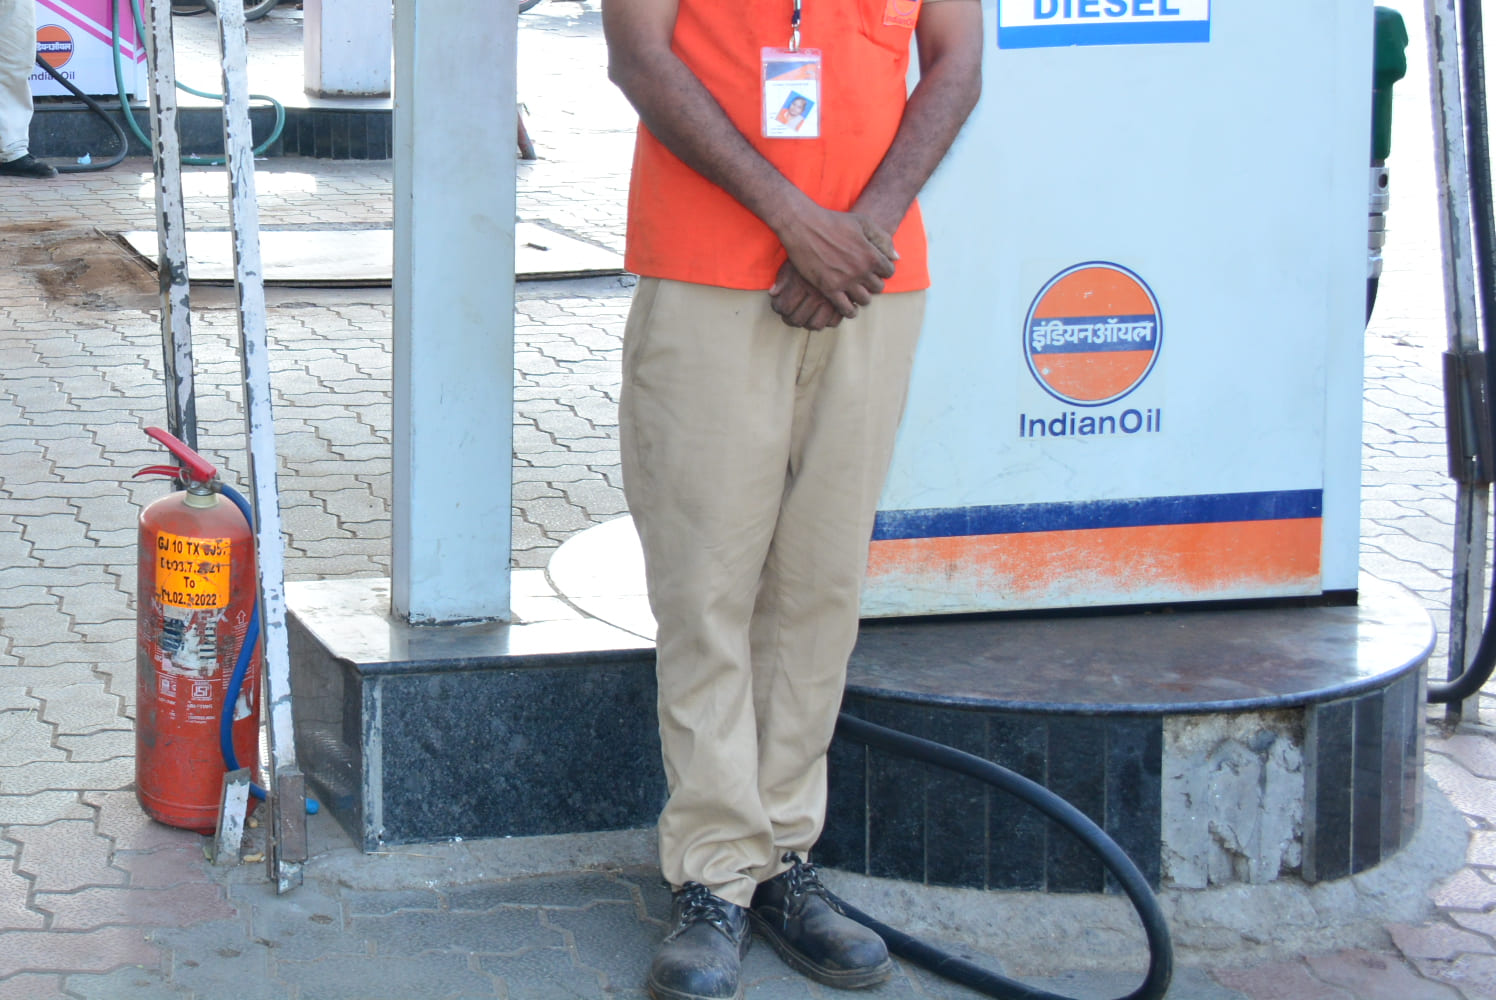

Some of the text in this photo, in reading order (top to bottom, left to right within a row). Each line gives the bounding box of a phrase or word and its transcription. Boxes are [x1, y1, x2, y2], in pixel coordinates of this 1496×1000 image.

[28, 71, 75, 81] ndiaOil
[1019, 408, 1162, 438] IndianOil
[158, 536, 170, 551] GJ
[172, 540, 183, 554] 10
[187, 542, 200, 556] TX
[184, 576, 196, 588] To
